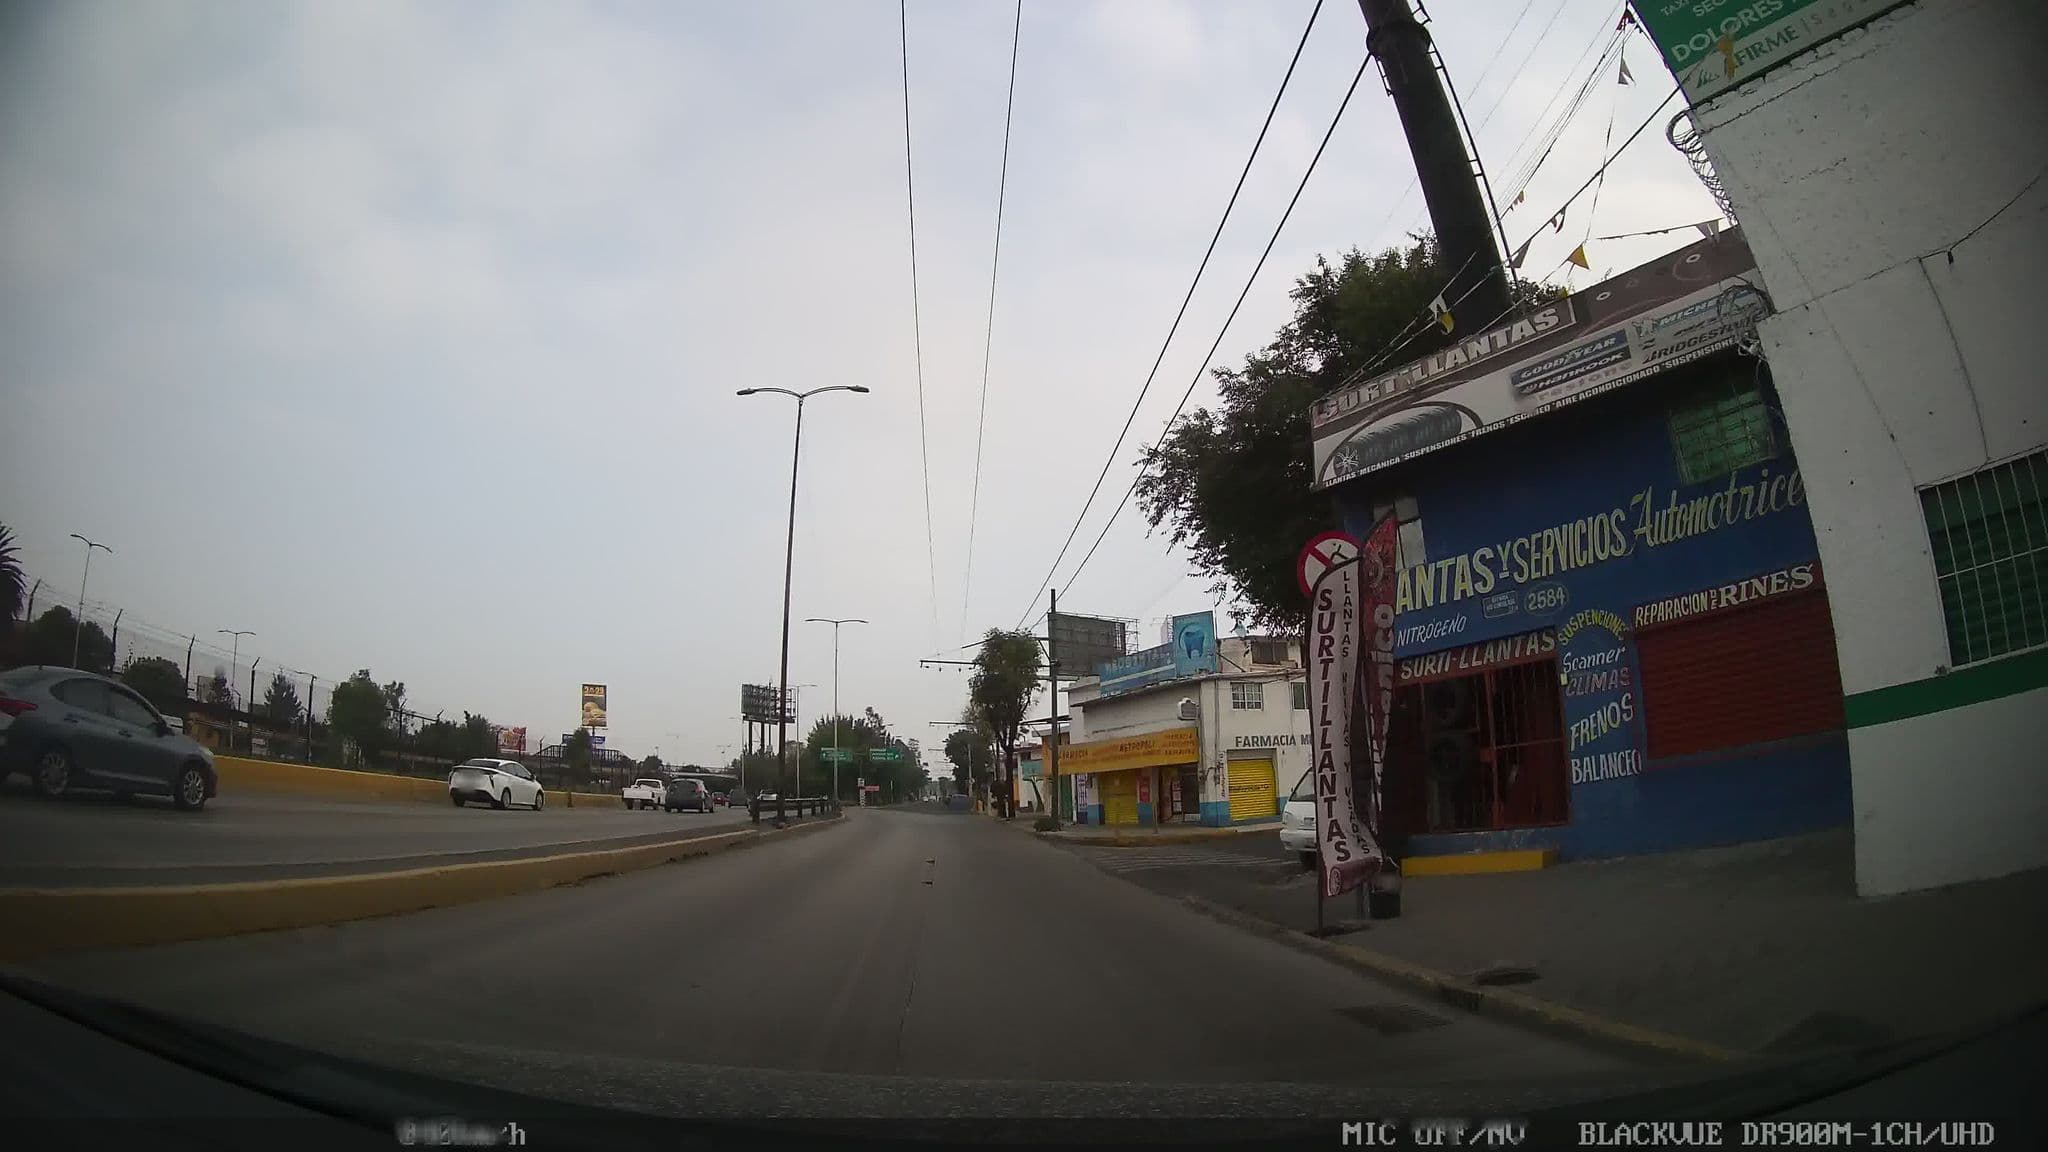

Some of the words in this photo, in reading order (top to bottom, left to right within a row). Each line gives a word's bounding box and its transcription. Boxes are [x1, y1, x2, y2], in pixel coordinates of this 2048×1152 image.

[1671, 0, 1784, 62] DOLORES
[1520, 337, 1617, 379] GOODYEAR
[1325, 472, 1356, 488] LLANTAS
[1509, 405, 1550, 426] ESCEO
[1665, 337, 1738, 369] SUSPENSIONE
[1395, 546, 1495, 616] ANTAS
[1498, 541, 1511, 579] Y
[1512, 508, 1627, 584] SERVICIOS
[1629, 469, 1804, 555] Automotrice
[1341, 570, 1353, 658] LLANTAS
[1527, 586, 1566, 610] 2584
[1635, 589, 1708, 628] REPARACION
[1718, 563, 1814, 608] RINES
[1562, 646, 1627, 674] Scanner
[1565, 666, 1631, 697] CLIMAS
[1235, 734, 1296, 748] FARMACIA
[1317, 588, 1351, 863] SURTILLANTAS
[1569, 692, 1634, 752] FRENOS
[1570, 748, 1642, 785] BALANCEO
